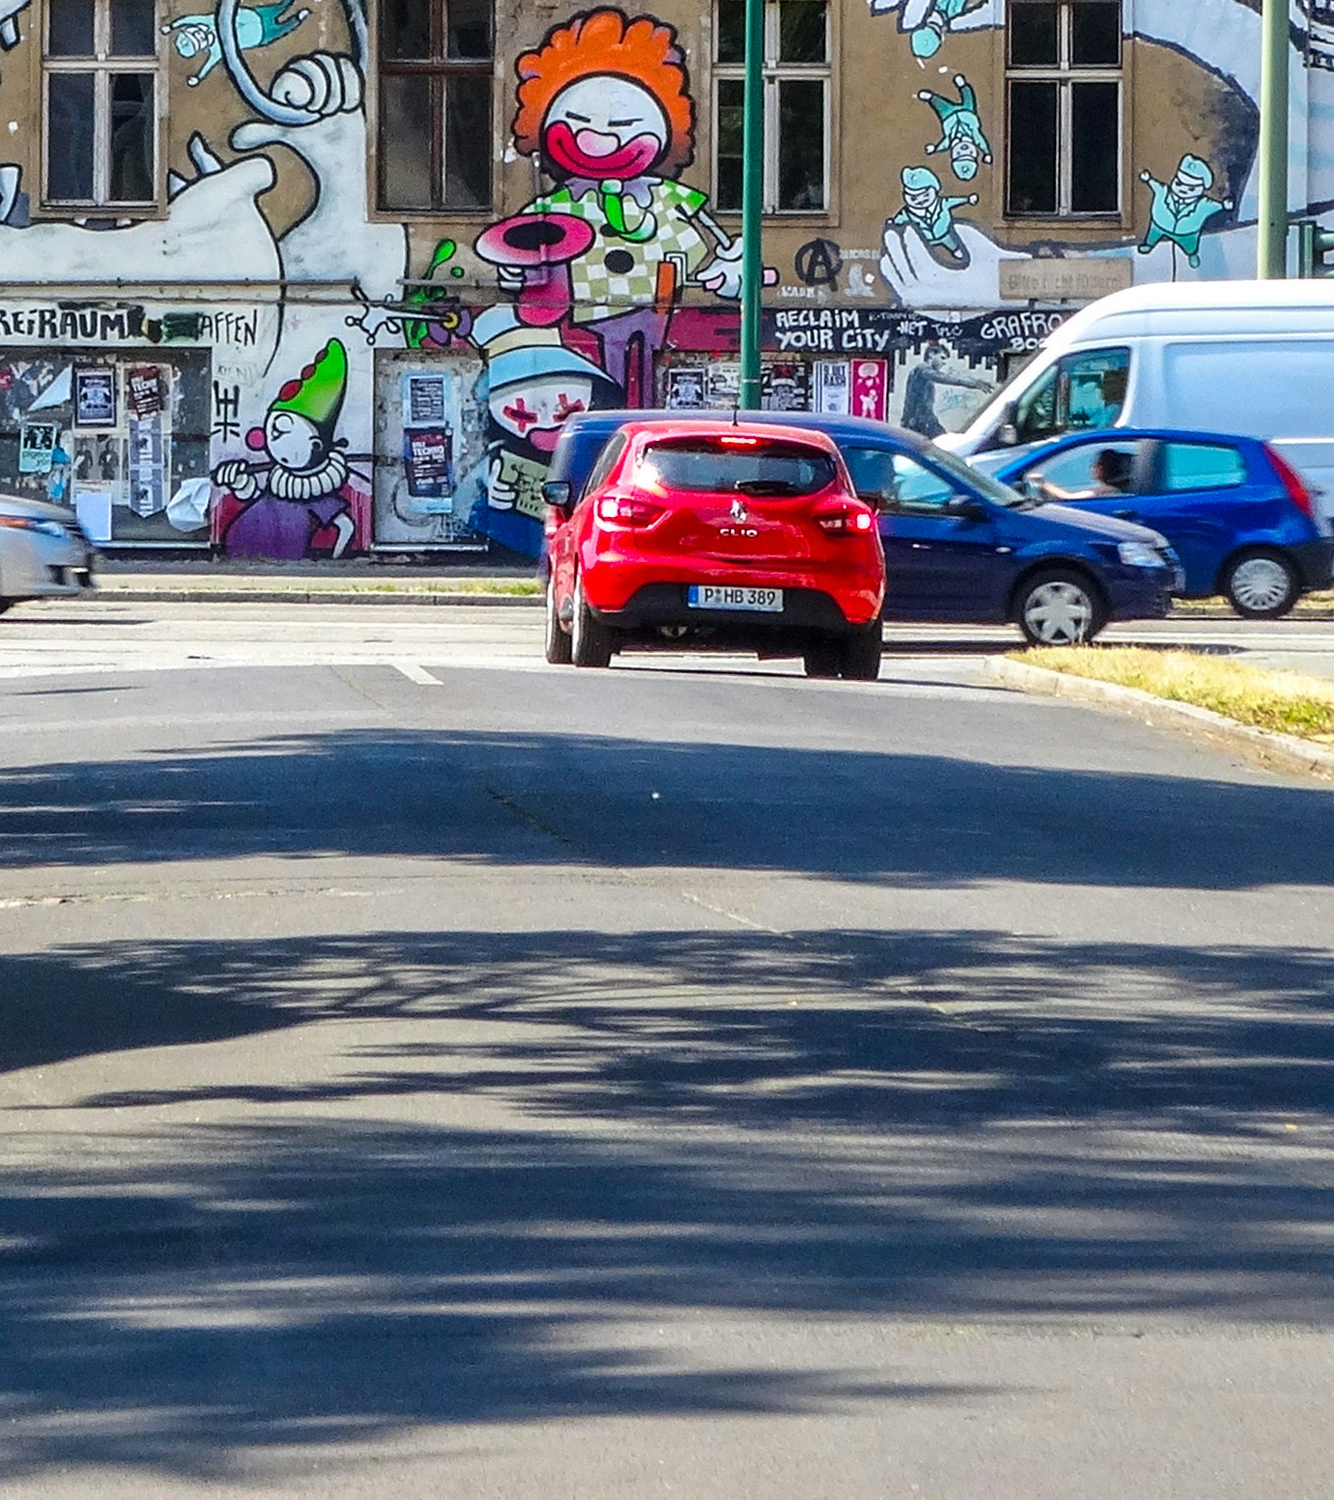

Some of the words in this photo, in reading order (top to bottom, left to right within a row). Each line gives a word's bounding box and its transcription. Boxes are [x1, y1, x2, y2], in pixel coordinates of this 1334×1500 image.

[775, 331, 834, 350] YOUR
[720, 528, 758, 537] CLIO
[704, 588, 714, 603] P
[724, 589, 744, 604] HB
[747, 590, 776, 606] 389
